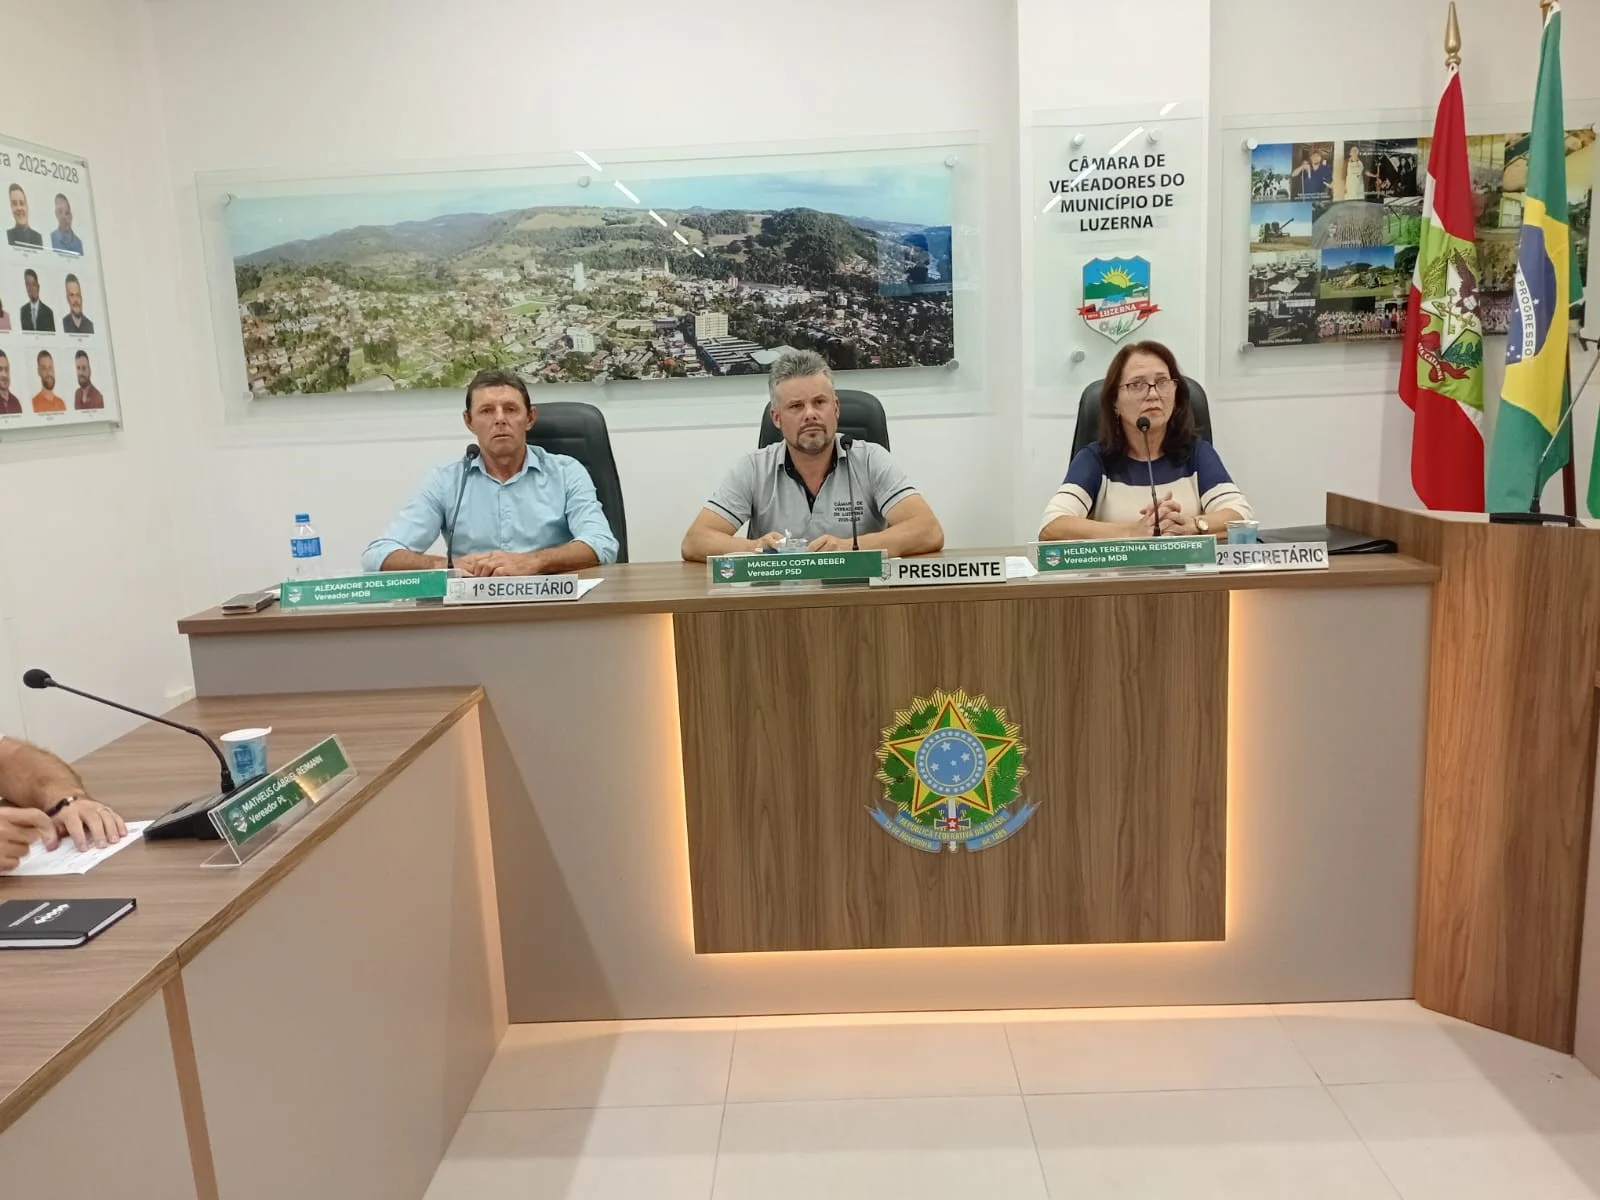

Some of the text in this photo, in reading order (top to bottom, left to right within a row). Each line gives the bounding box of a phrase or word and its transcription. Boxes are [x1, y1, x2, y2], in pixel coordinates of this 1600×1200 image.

[17, 152, 80, 184] 2025-2028
[1068, 154, 1166, 173] CÂMARA DE
[1049, 173, 1185, 194] VEREADORES DO
[1060, 193, 1174, 213] MUNICÍPIO DE
[1080, 215, 1154, 232] LUZERNA
[1099, 303, 1137, 318] LUZERNA
[1517, 280, 1534, 357] PROGRESSO
[1063, 541, 1203, 556] HELENA TEREZINHA REISDORFER
[747, 557, 846, 568] MARCELO COSTA BEBER
[1064, 554, 1128, 564] Vereadora MDB
[747, 568, 802, 577] Vereador PSD
[899, 562, 1001, 579] PRESIDENTE
[314, 578, 420, 592] ALEXANDRE JOEL SIGNORI
[472, 578, 574, 597] 1º SECRETÁRIO
[314, 590, 370, 601] Vereador MDB
[241, 755, 324, 813] MATHEUS GABRIEL REIMANN
[248, 794, 287, 824] Vereador PL
